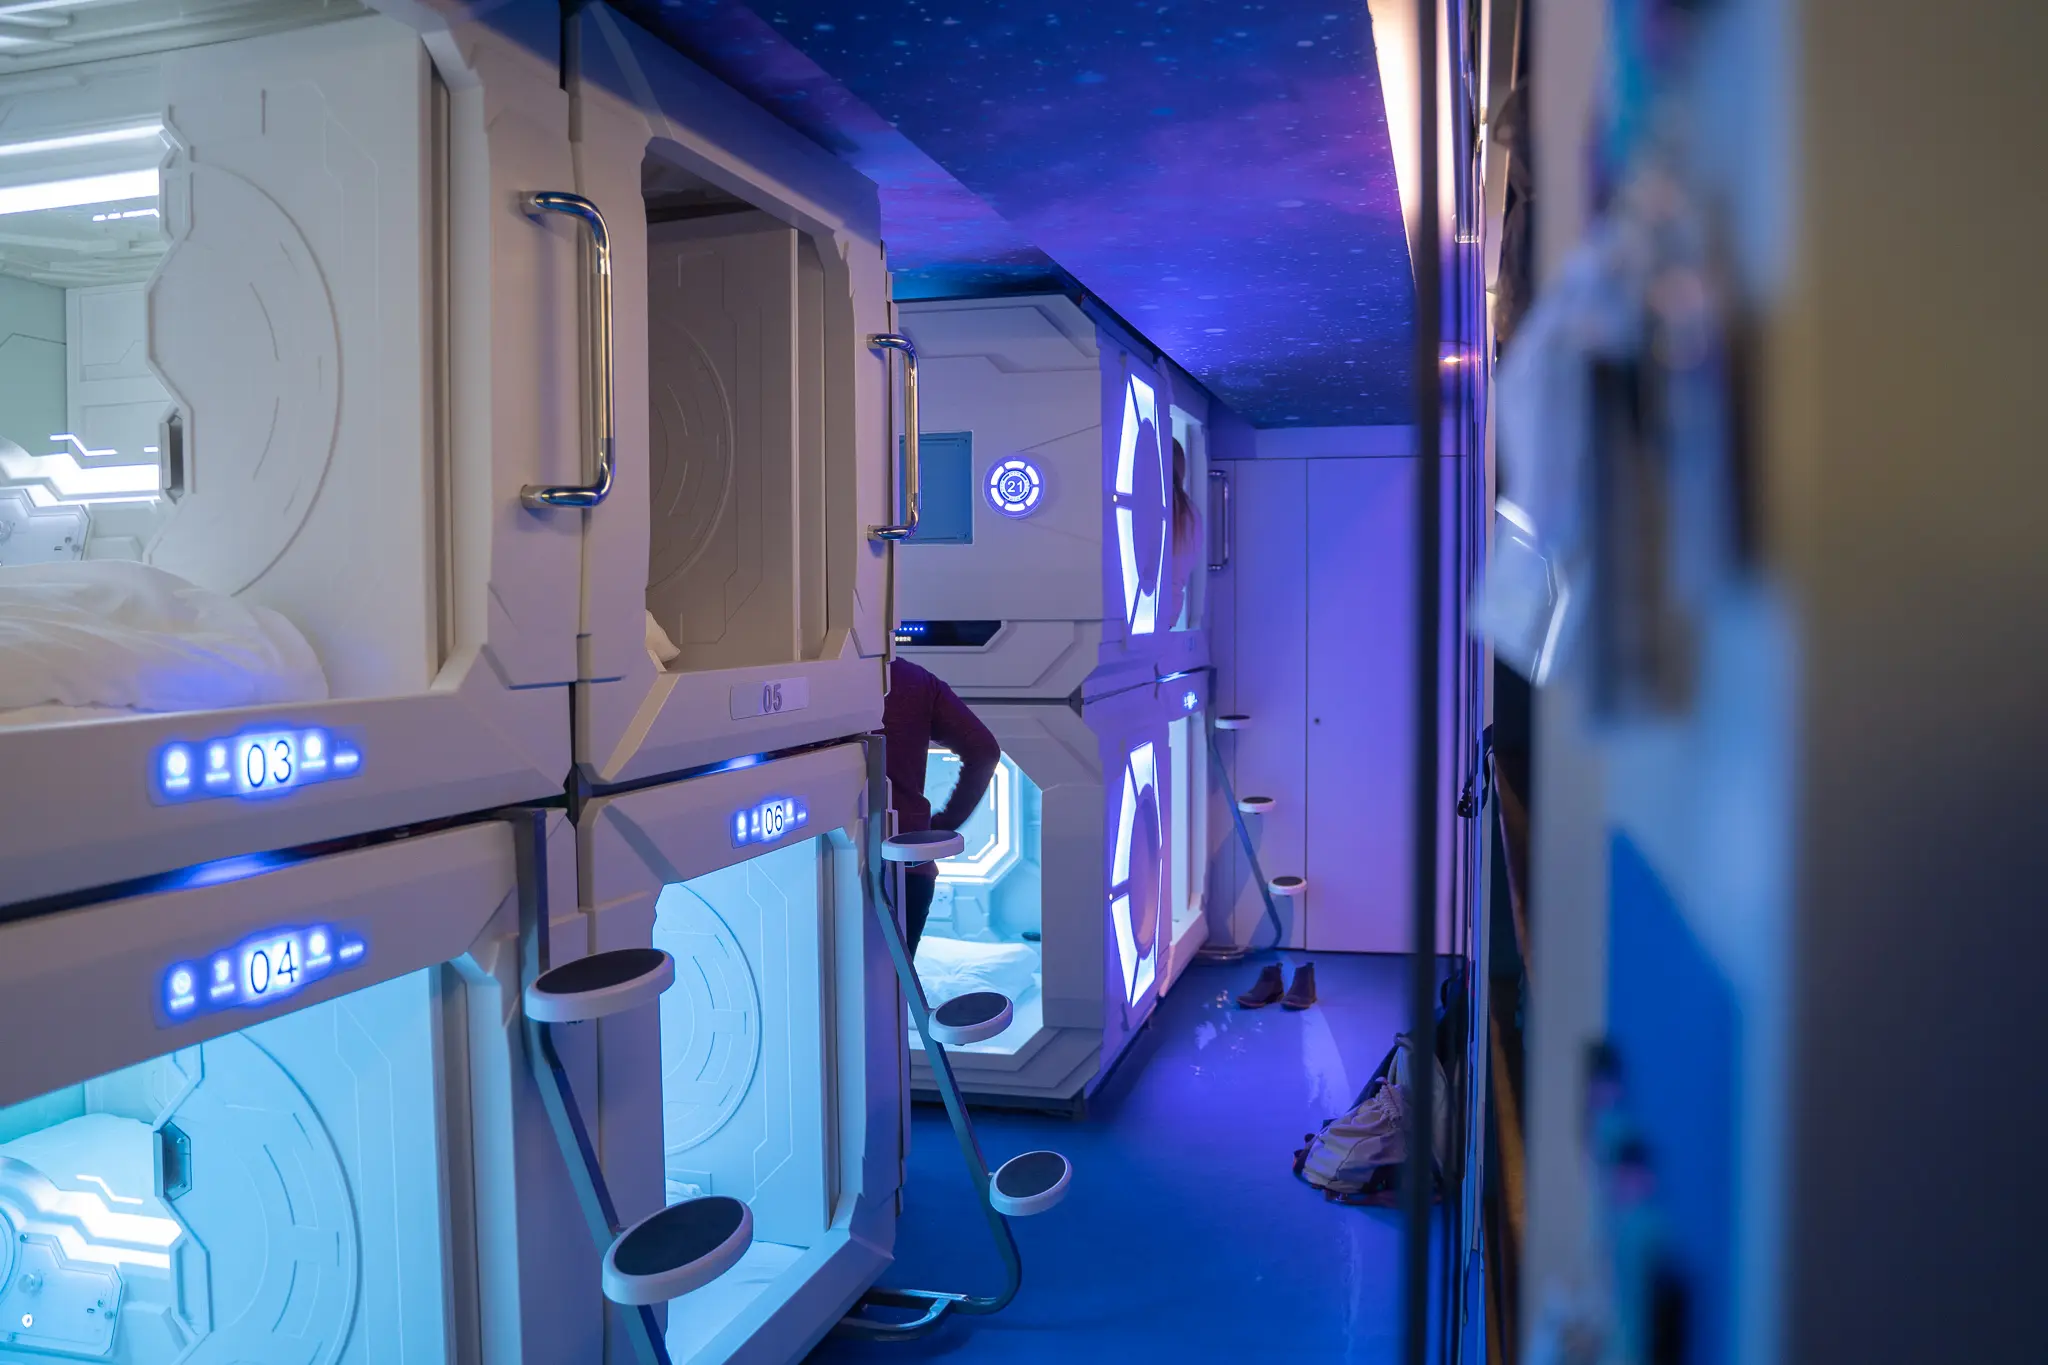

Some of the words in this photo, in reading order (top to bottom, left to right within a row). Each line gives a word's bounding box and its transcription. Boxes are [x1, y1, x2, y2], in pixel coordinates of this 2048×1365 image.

[1007, 480, 1023, 493] 21
[763, 683, 782, 713] 05
[247, 740, 292, 788] 03
[765, 804, 783, 835] 06
[250, 941, 299, 994] 04
